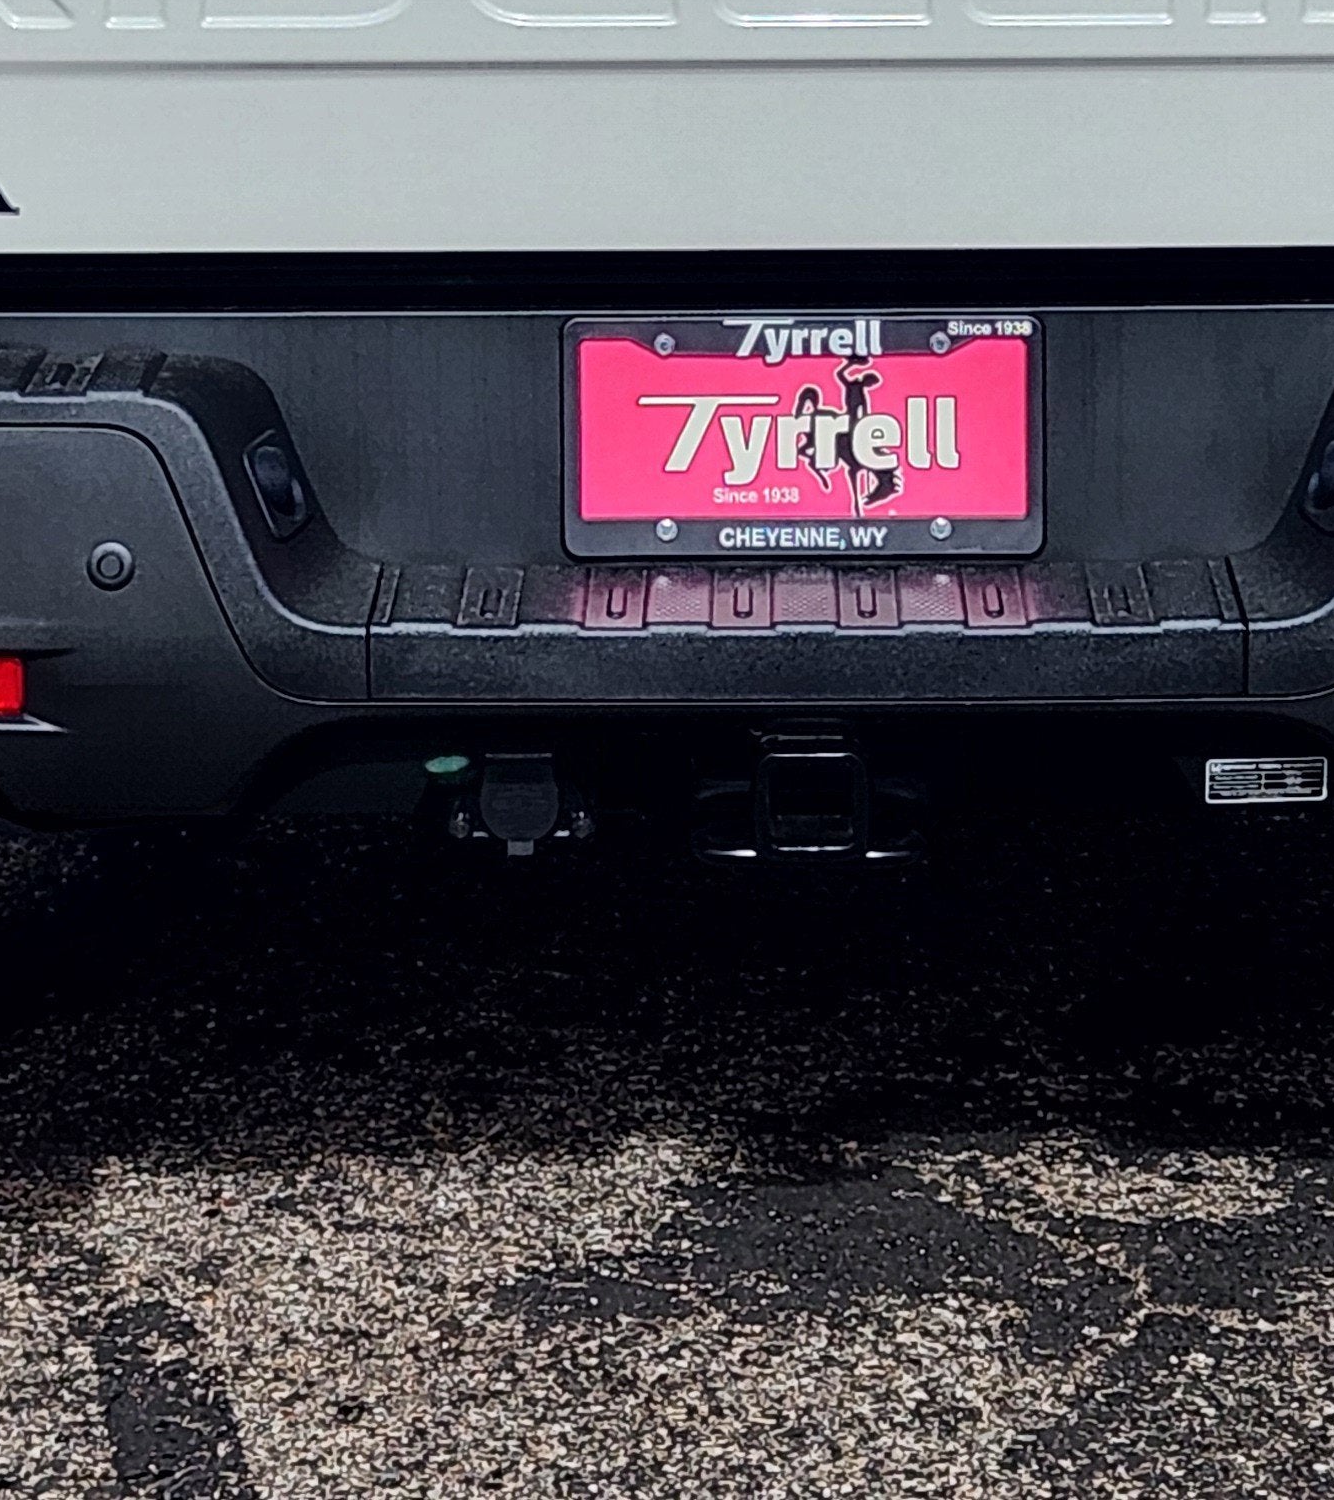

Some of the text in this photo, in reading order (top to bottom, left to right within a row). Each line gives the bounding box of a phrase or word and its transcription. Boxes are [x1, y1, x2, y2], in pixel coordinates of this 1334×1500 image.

[947, 320, 1033, 336] Since 1938
[722, 318, 883, 364] Tyrrell
[637, 395, 960, 486] Tyrrell
[713, 486, 801, 504] Since 1938
[718, 526, 888, 550] CHEYENNE, WY
